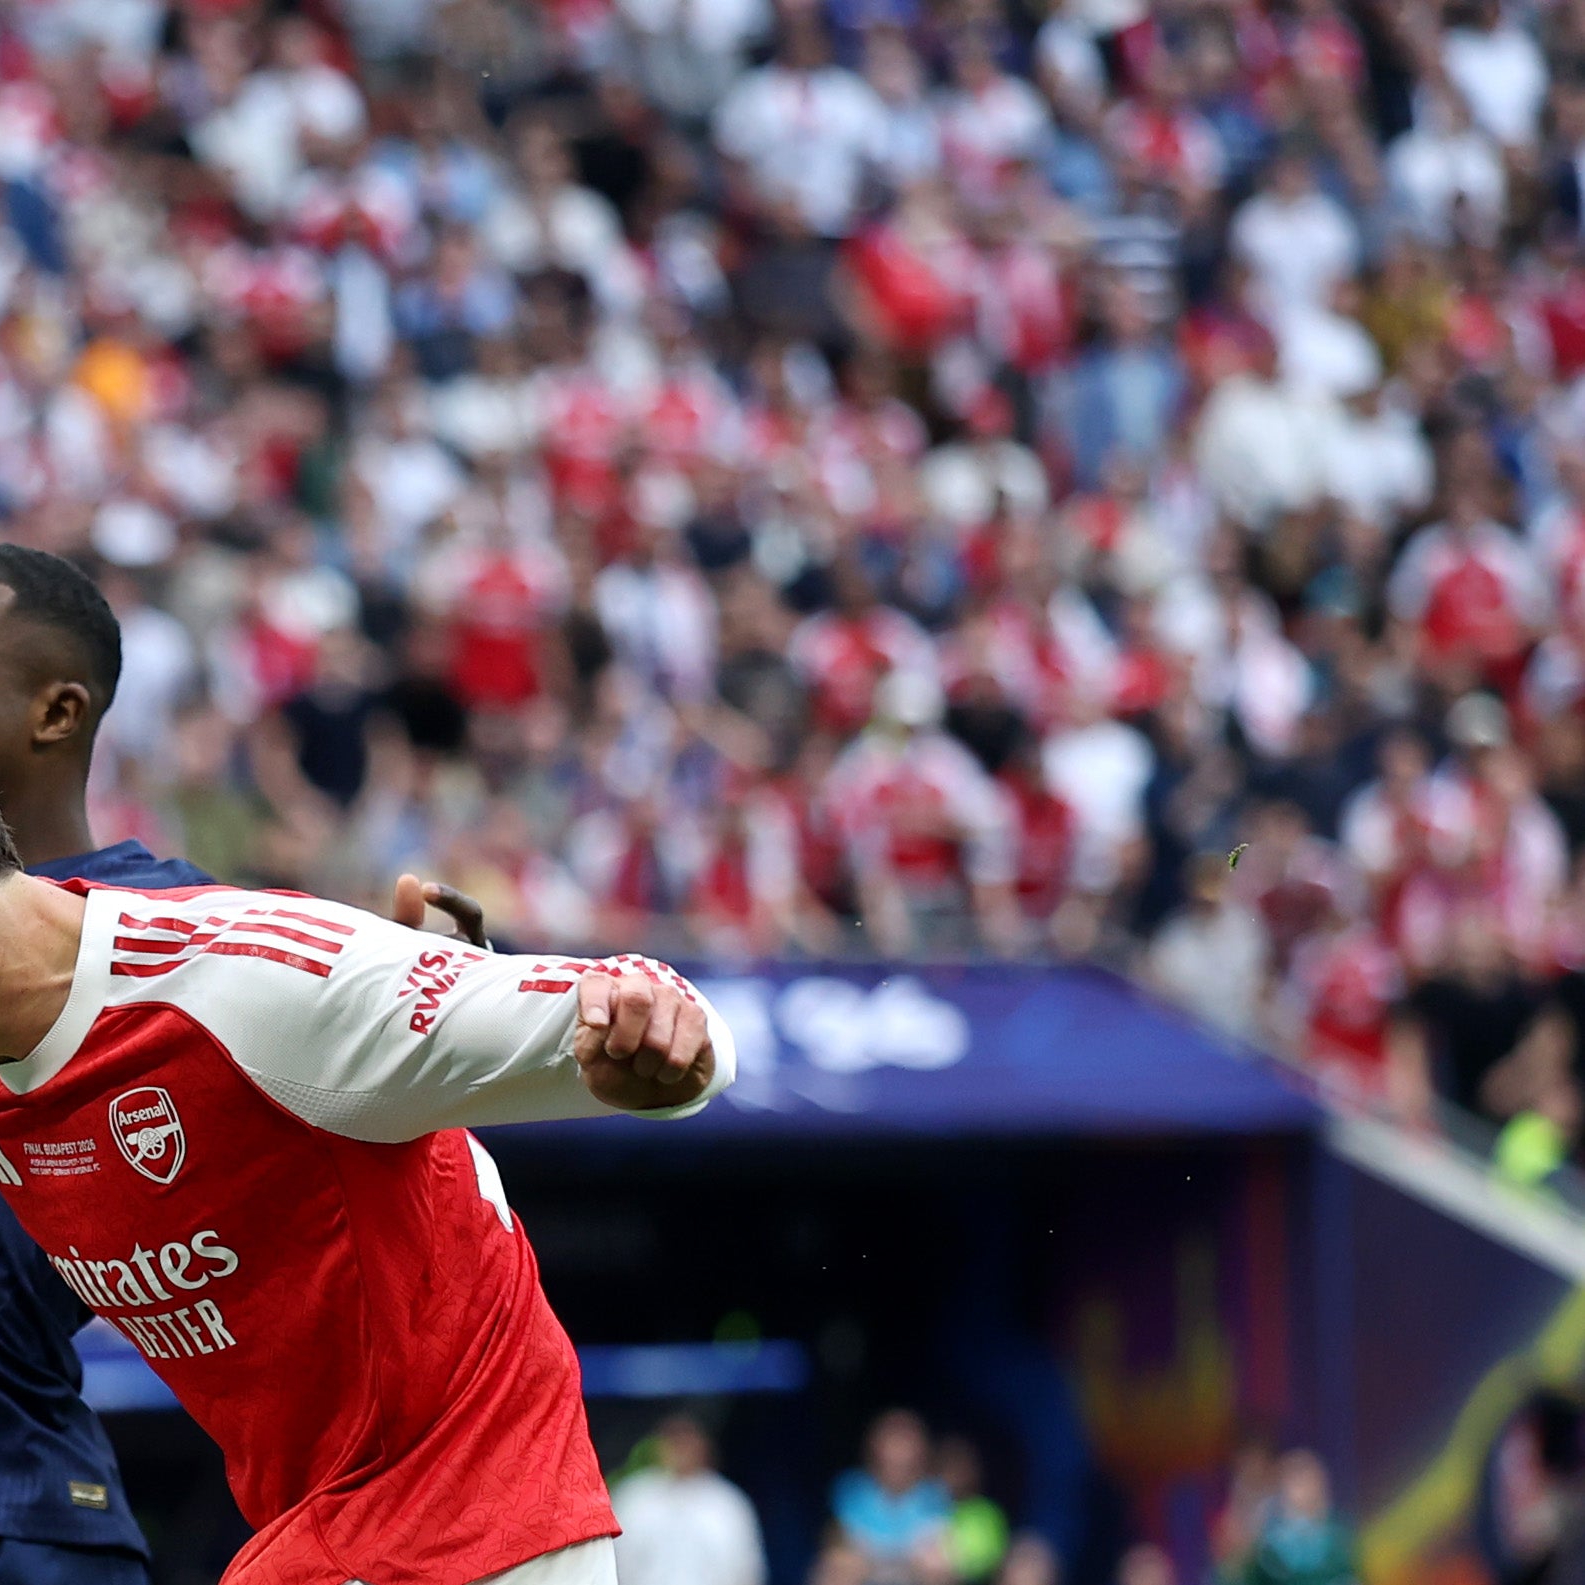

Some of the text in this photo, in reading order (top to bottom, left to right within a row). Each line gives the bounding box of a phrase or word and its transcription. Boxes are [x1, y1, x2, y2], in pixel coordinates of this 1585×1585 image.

[118, 1100, 167, 1127] Arsenal
[23, 1138, 97, 1156] FINAL BUDAPEST 2026
[47, 1230, 239, 1307] mirates
[118, 1299, 237, 1358] BETTER
